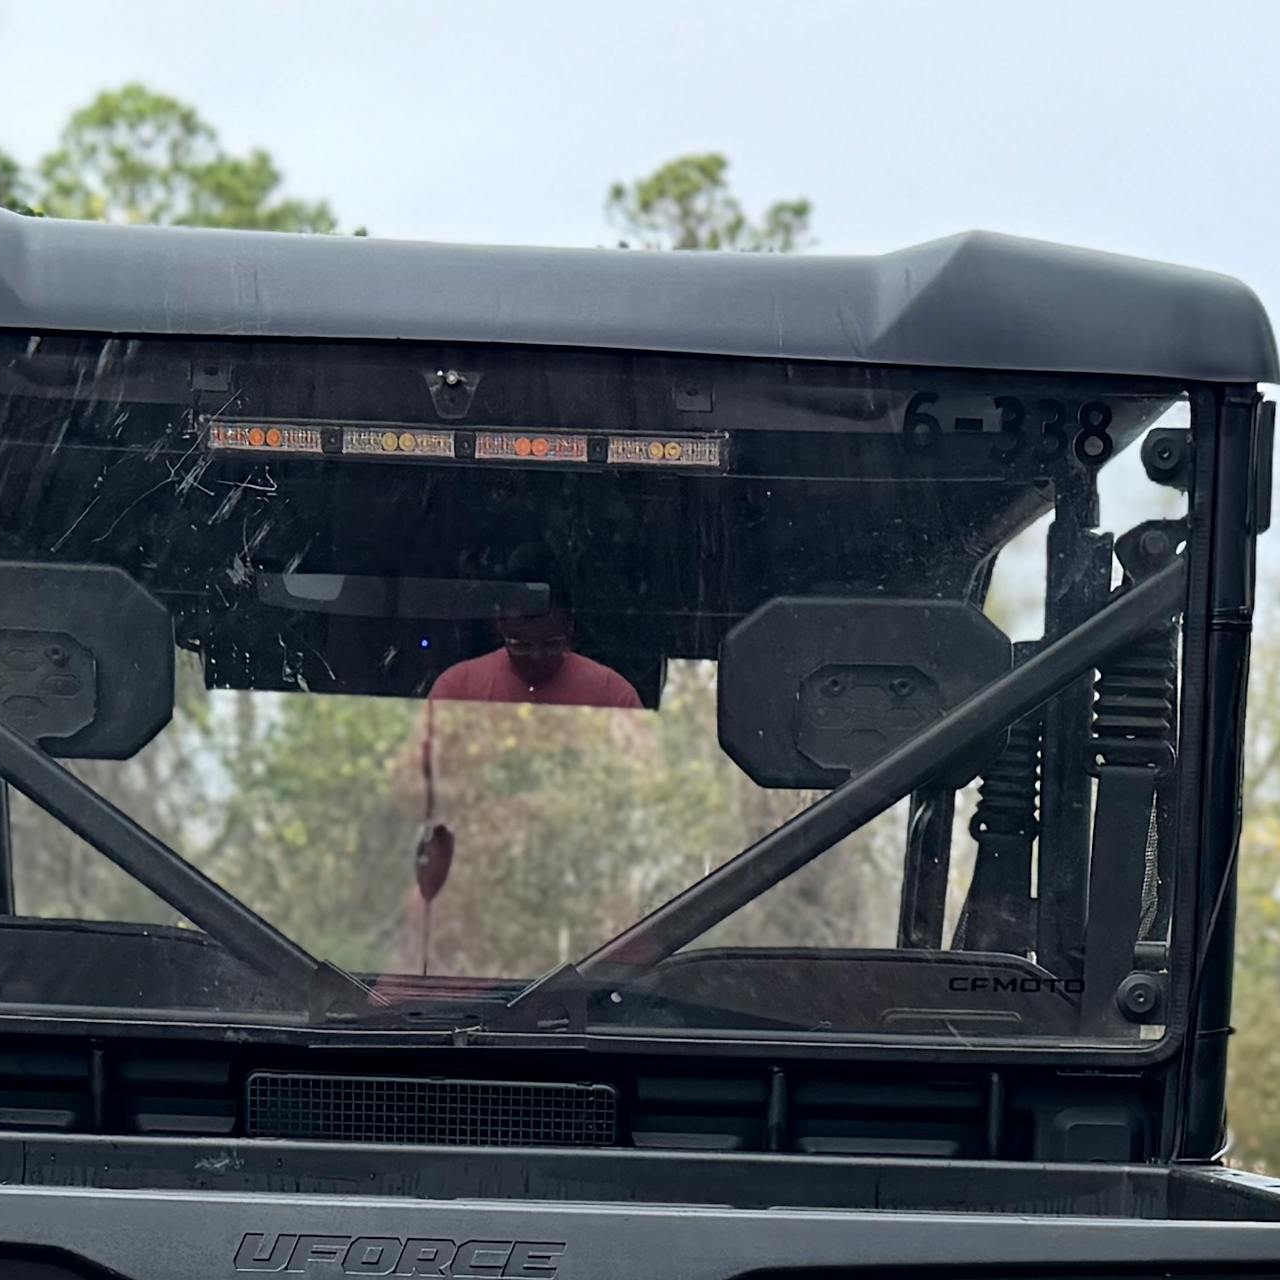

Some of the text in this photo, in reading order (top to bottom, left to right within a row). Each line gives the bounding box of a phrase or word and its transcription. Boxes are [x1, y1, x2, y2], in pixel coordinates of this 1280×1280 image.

[903, 391, 1113, 465] 6-338
[949, 977, 1086, 994] CFMOTO
[233, 1232, 567, 1280] UFORCE
